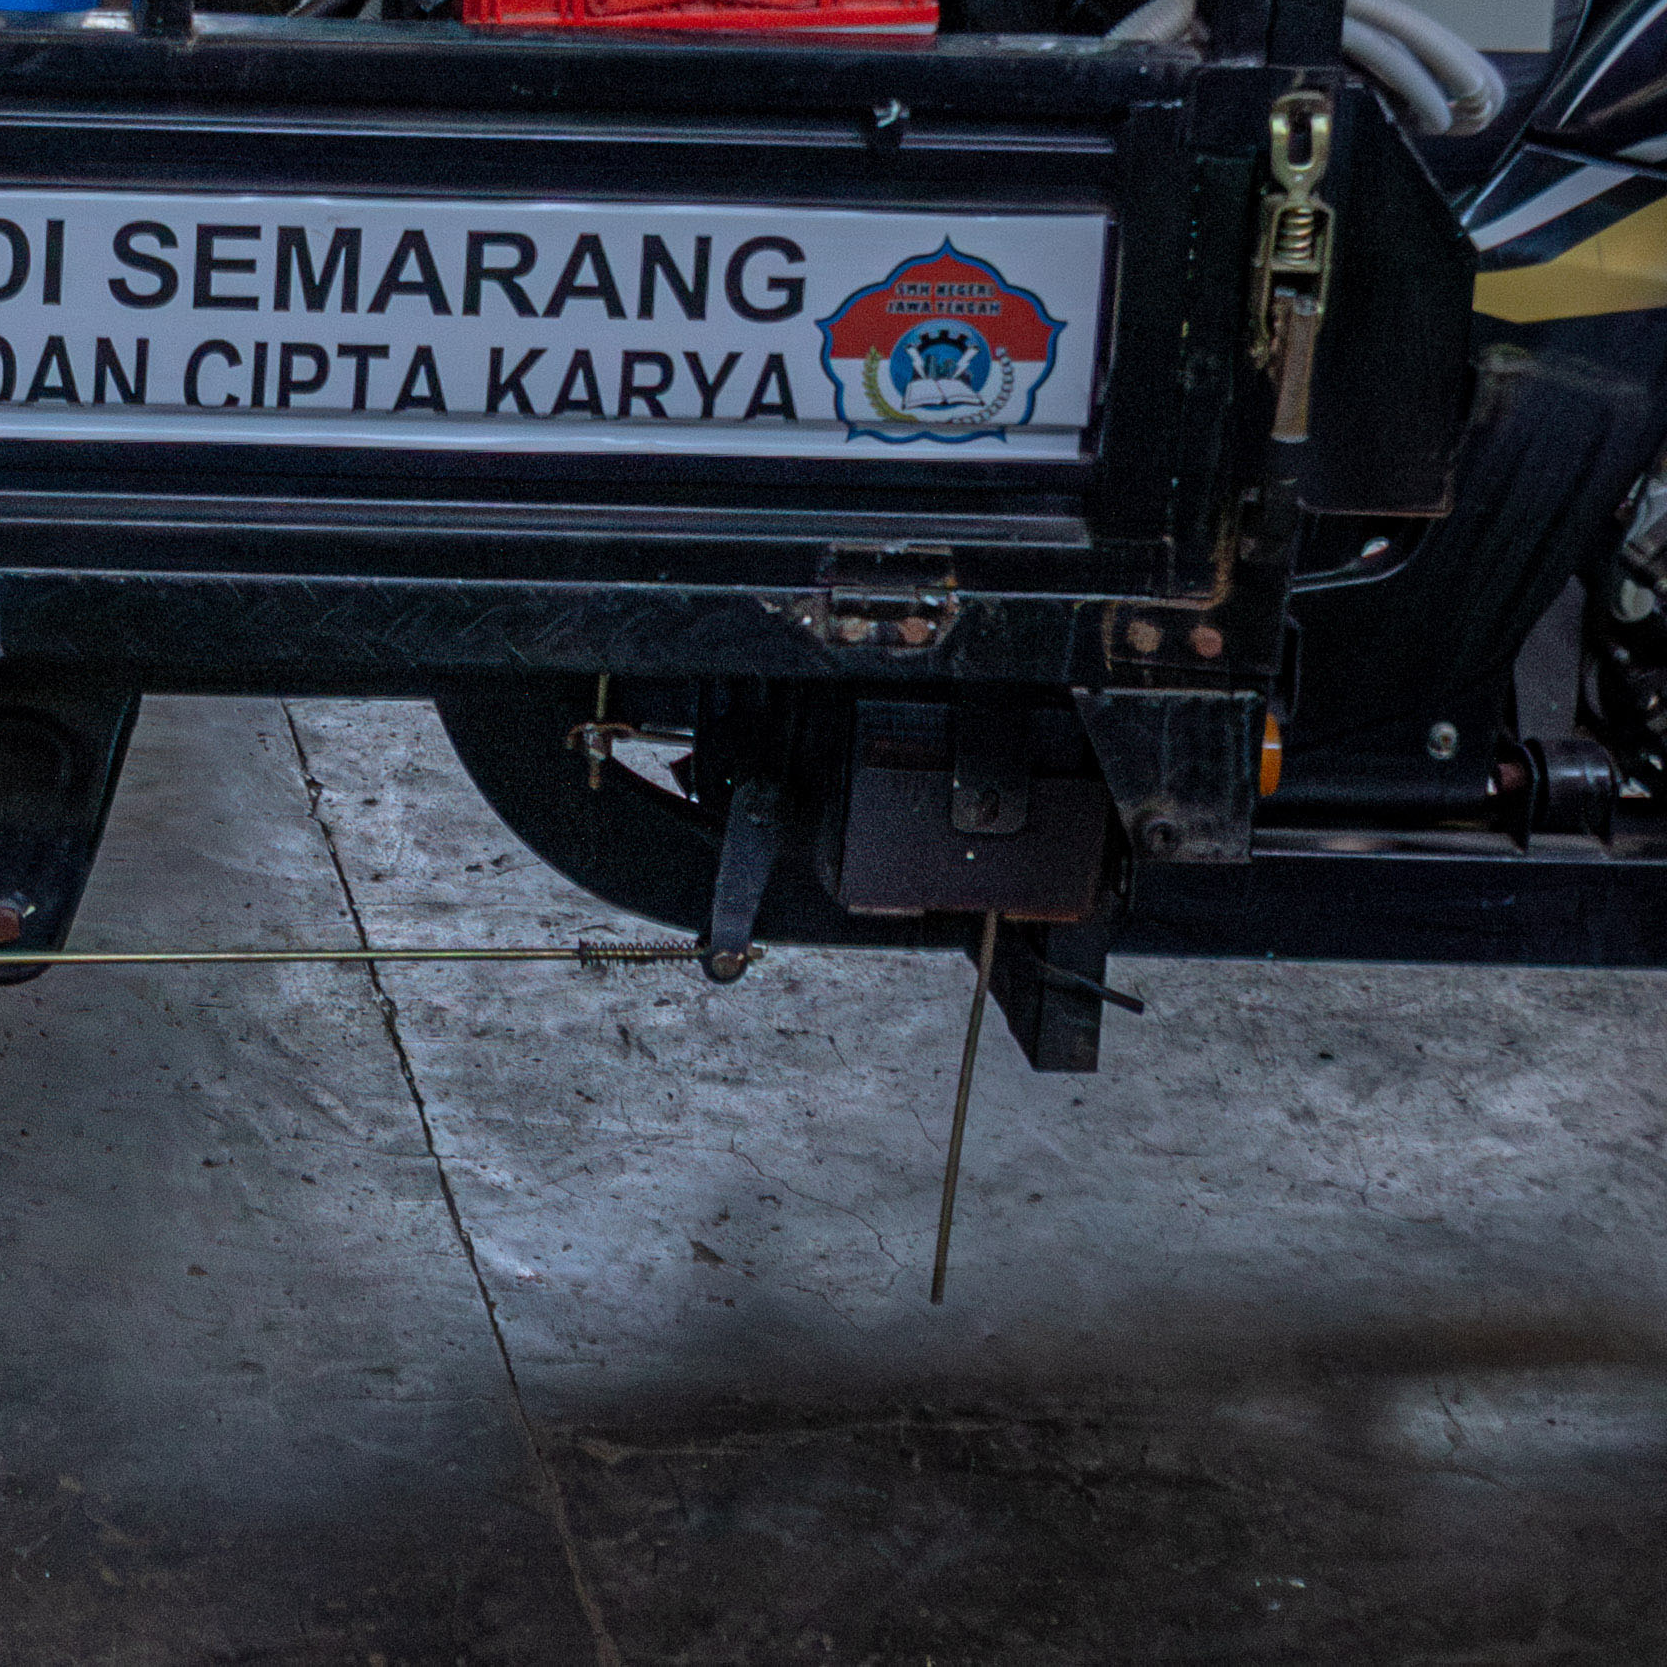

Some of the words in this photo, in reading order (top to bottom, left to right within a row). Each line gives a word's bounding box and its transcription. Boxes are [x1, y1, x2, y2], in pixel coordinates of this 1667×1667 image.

[107, 219, 807, 323] SEMARANG
[182, 338, 449, 415] CIPTA
[484, 346, 798, 421] KARYA
